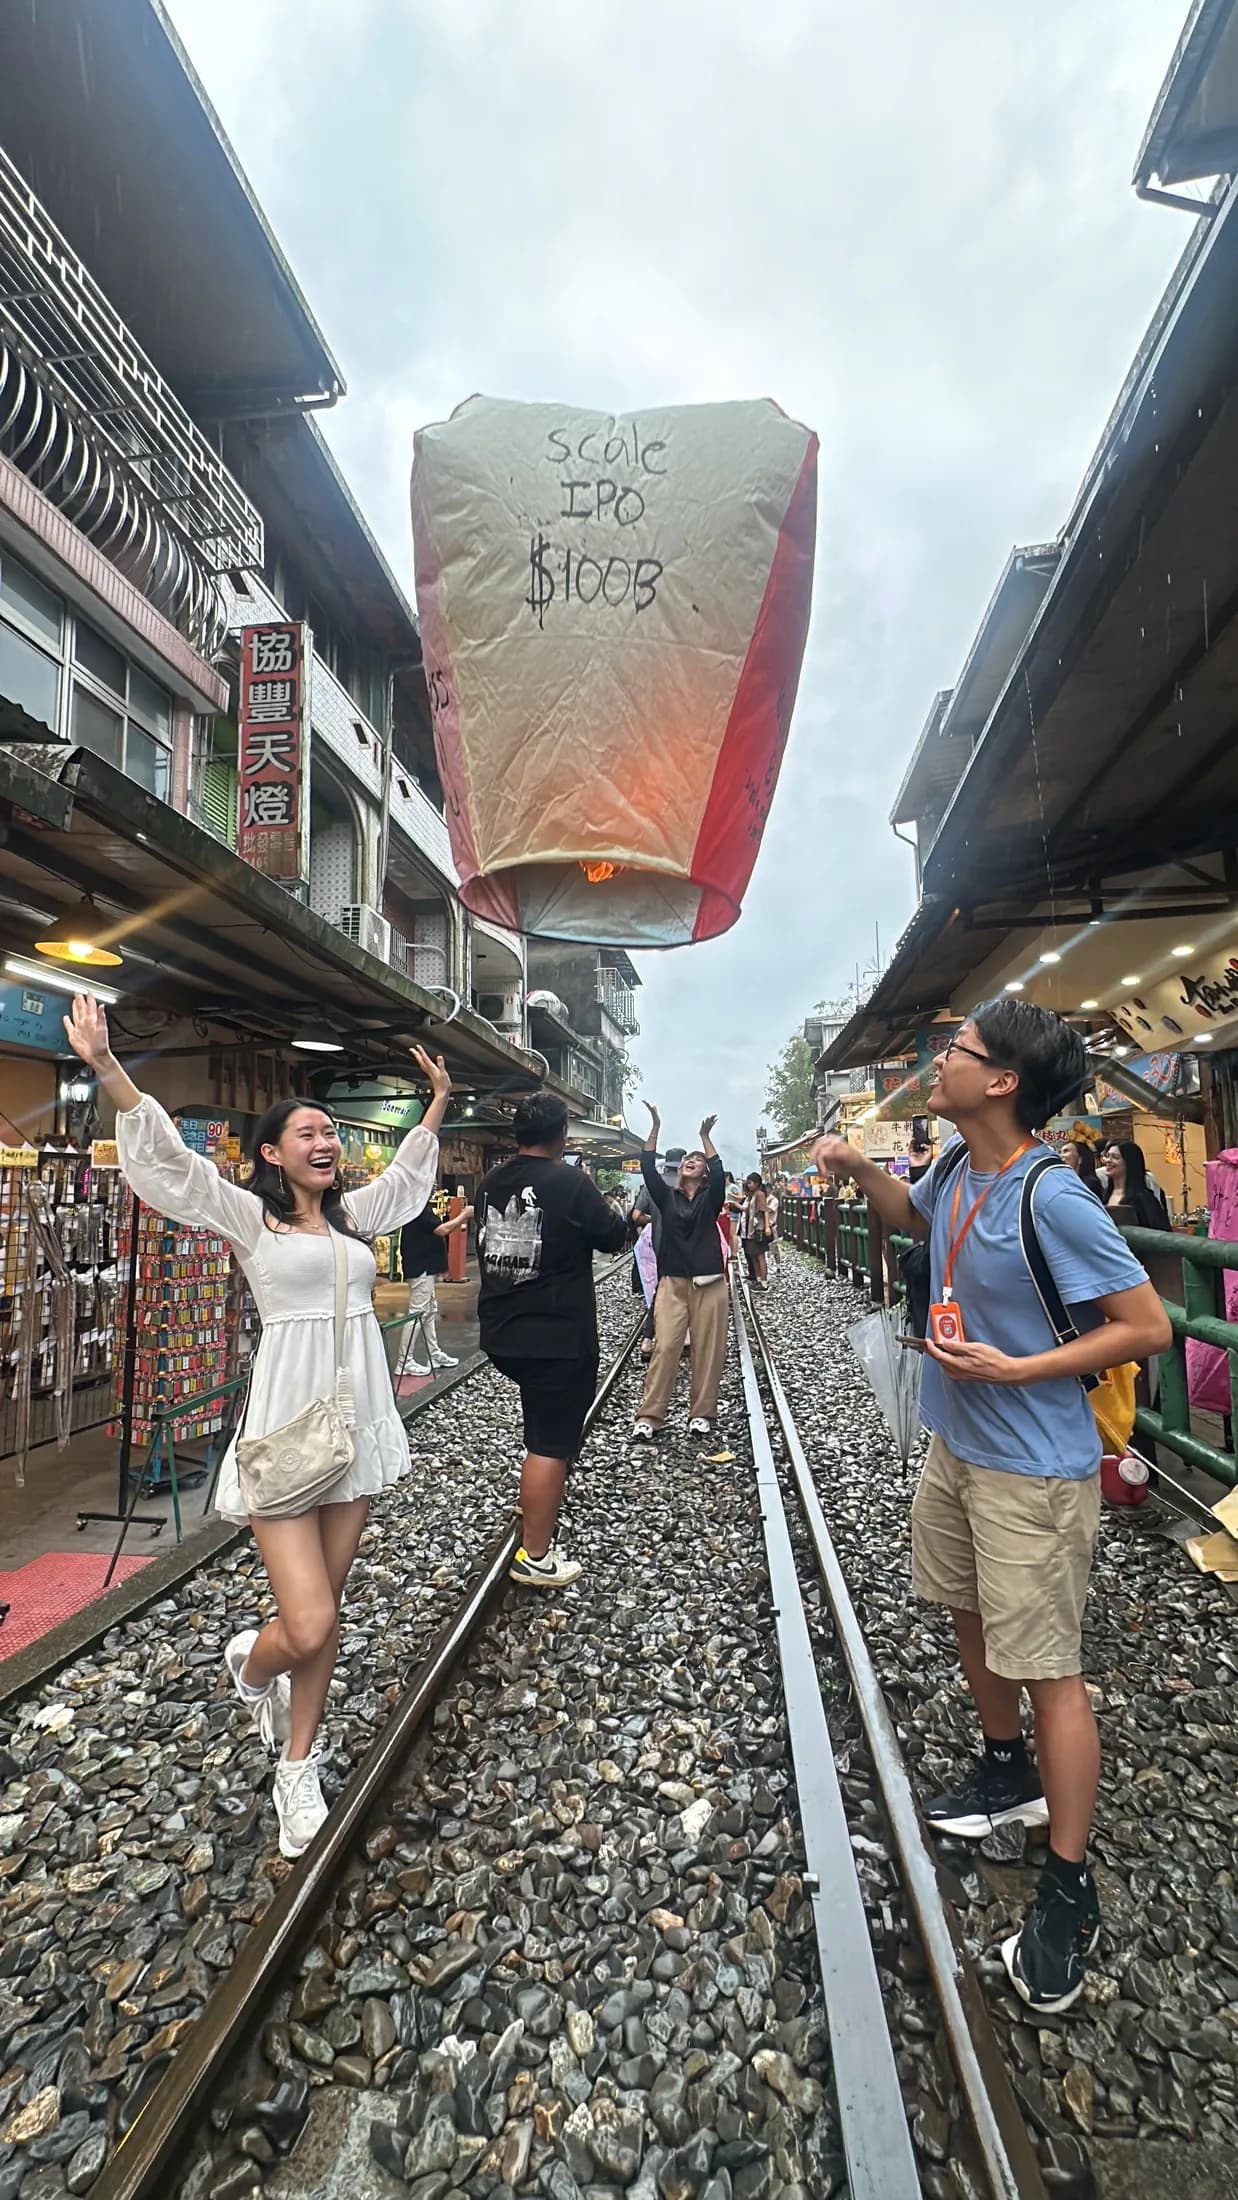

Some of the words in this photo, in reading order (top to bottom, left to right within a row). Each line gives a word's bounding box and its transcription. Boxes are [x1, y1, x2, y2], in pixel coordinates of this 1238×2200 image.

[560, 479, 645, 526] IPO
[526, 532, 663, 630] $100B
[243, 631, 292, 828] 協豐天燈
[243, 831, 297, 853] 批發
[207, 1122, 224, 1138] 90
